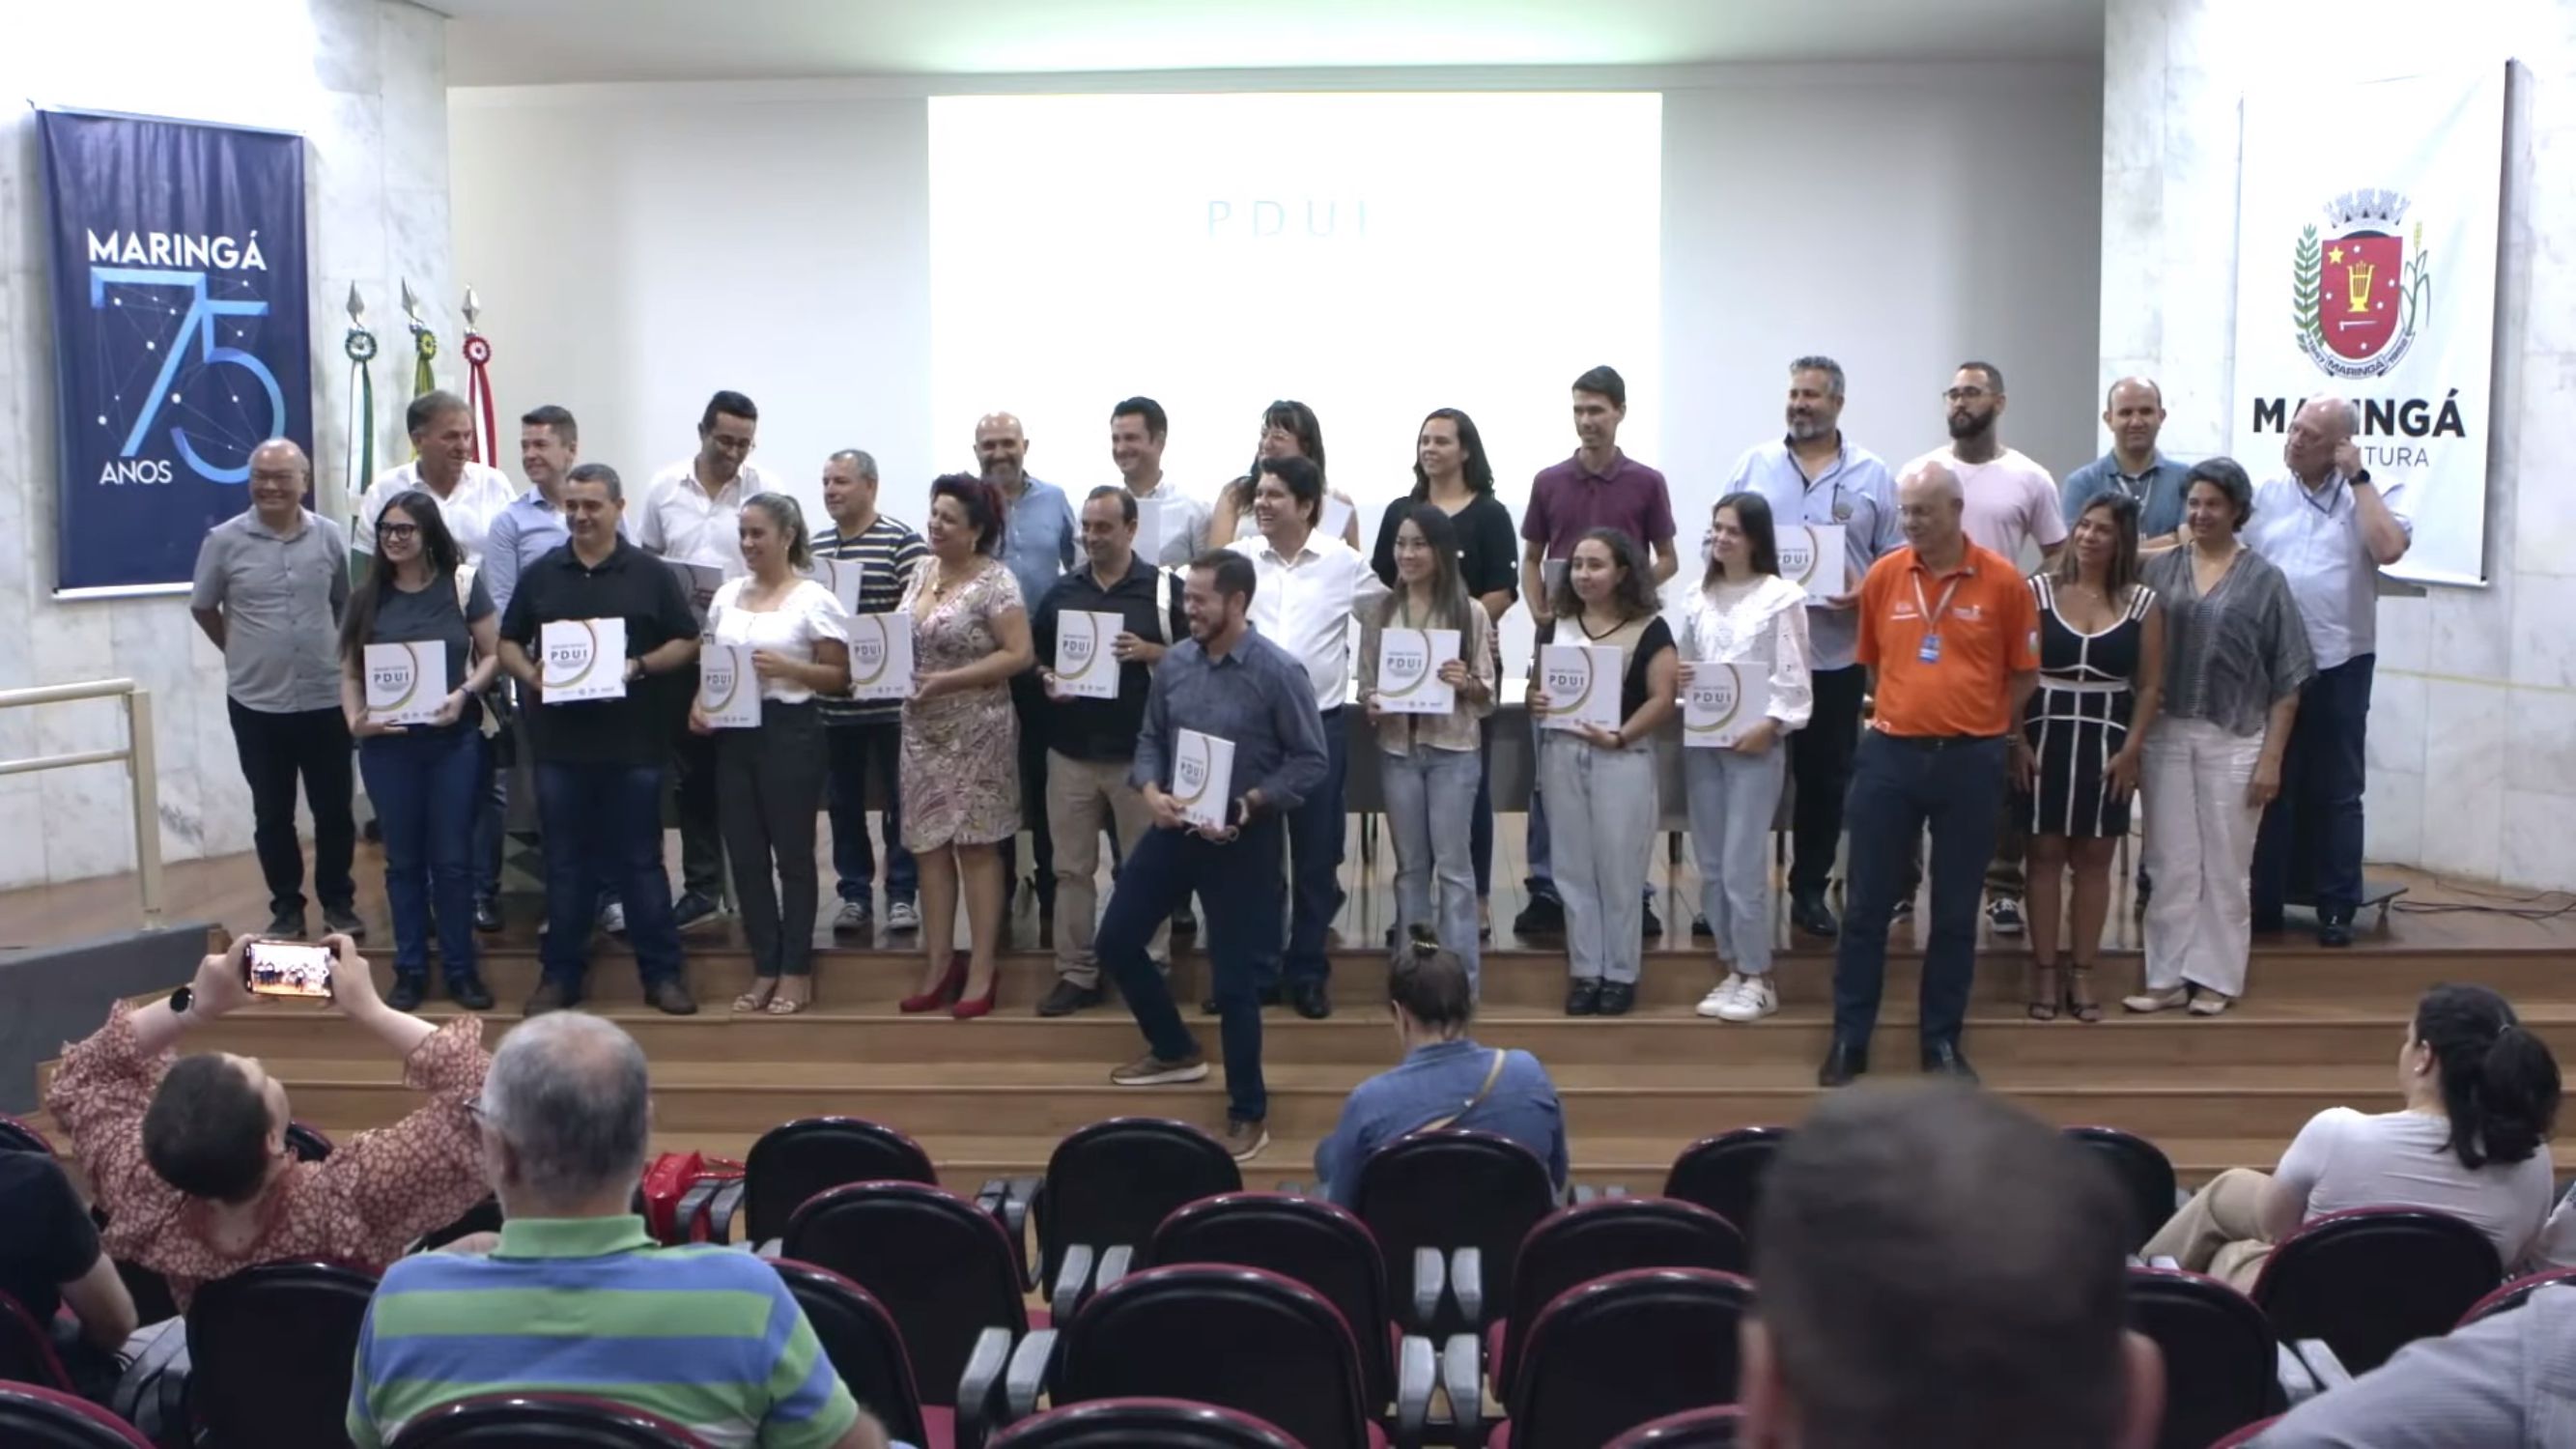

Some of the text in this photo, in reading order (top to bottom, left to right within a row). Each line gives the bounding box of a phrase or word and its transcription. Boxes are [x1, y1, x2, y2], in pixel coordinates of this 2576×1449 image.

[86, 227, 268, 271] MARINGÁ
[90, 266, 286, 484] 75
[2252, 387, 2466, 438] MNGÁ
[99, 460, 173, 485] ANOS
[1063, 639, 1090, 652] PDUI
[551, 649, 587, 660] PDUI
[1387, 657, 1422, 668] PDUI
[374, 671, 409, 683] PDUI
[1549, 674, 1584, 686] PDUI
[1693, 692, 1732, 702] PDUI
